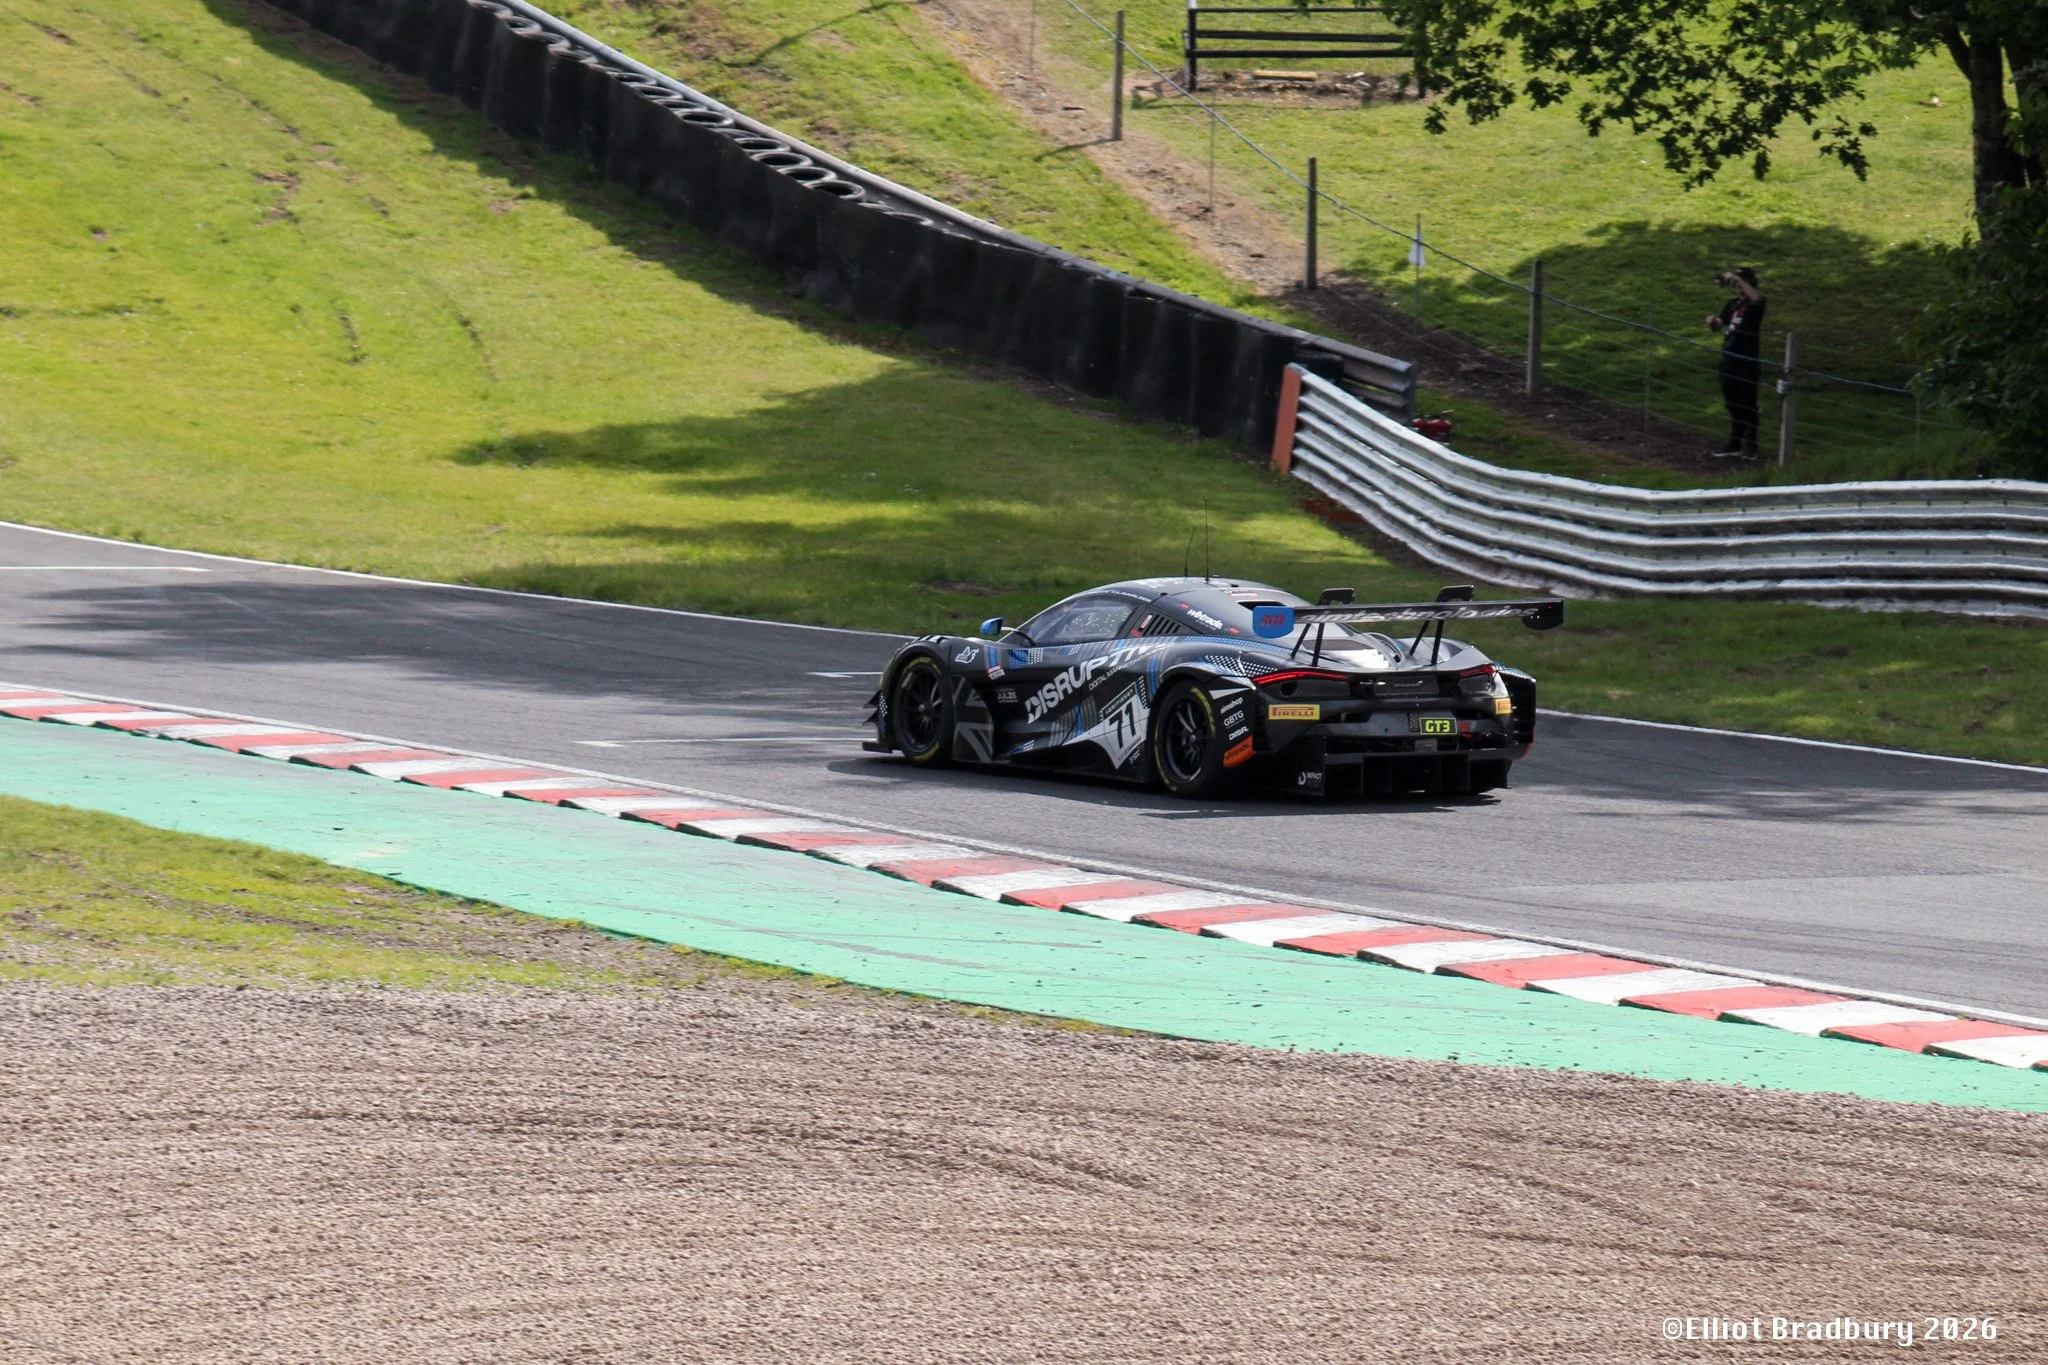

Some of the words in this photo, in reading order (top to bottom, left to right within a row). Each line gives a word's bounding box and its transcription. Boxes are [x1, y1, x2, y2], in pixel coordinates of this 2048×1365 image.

[1088, 674, 1108, 691] DIGITAL
[1221, 697, 1243, 714] aimshop
[1272, 706, 1314, 717] PIRELLI
[1109, 701, 1136, 749] 71
[1223, 710, 1244, 726] GBTG
[1425, 720, 1451, 733] GT3
